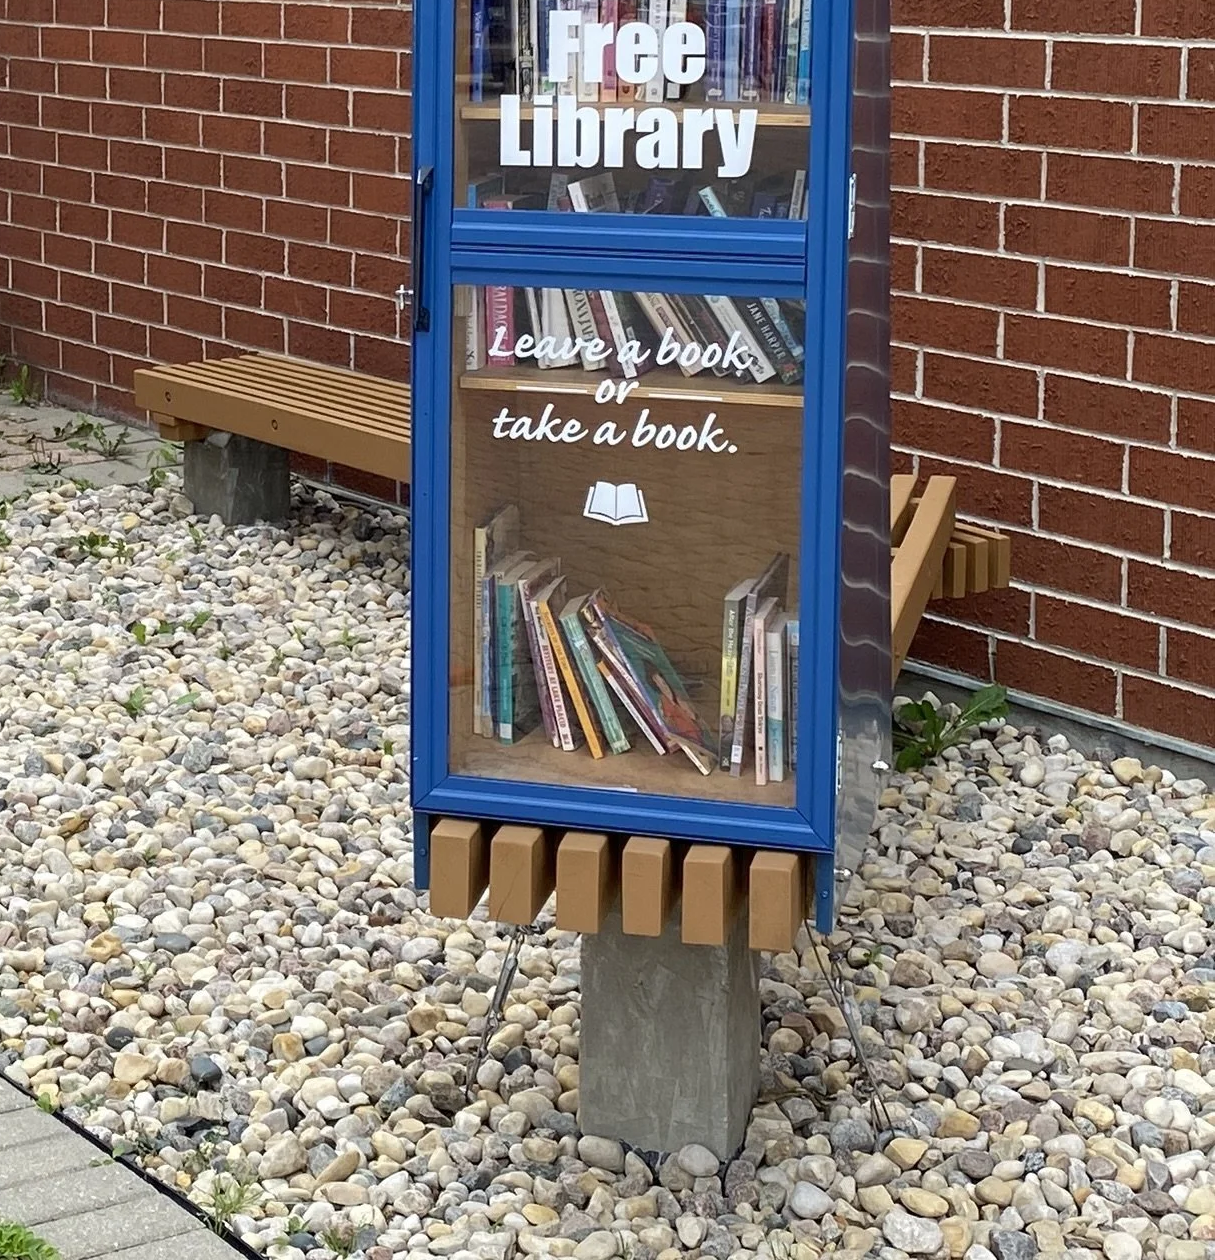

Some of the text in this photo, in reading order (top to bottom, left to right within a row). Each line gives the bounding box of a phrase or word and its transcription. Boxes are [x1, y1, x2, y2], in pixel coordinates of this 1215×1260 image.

[548, 10, 706, 84] Free
[500, 94, 758, 178] Library
[488, 326, 613, 362] Leave
[617, 339, 651, 364] a
[744, 299, 788, 360] JANE HARPER
[595, 379, 639, 405] or
[492, 403, 738, 453] take a book.
[726, 609, 736, 626] After
